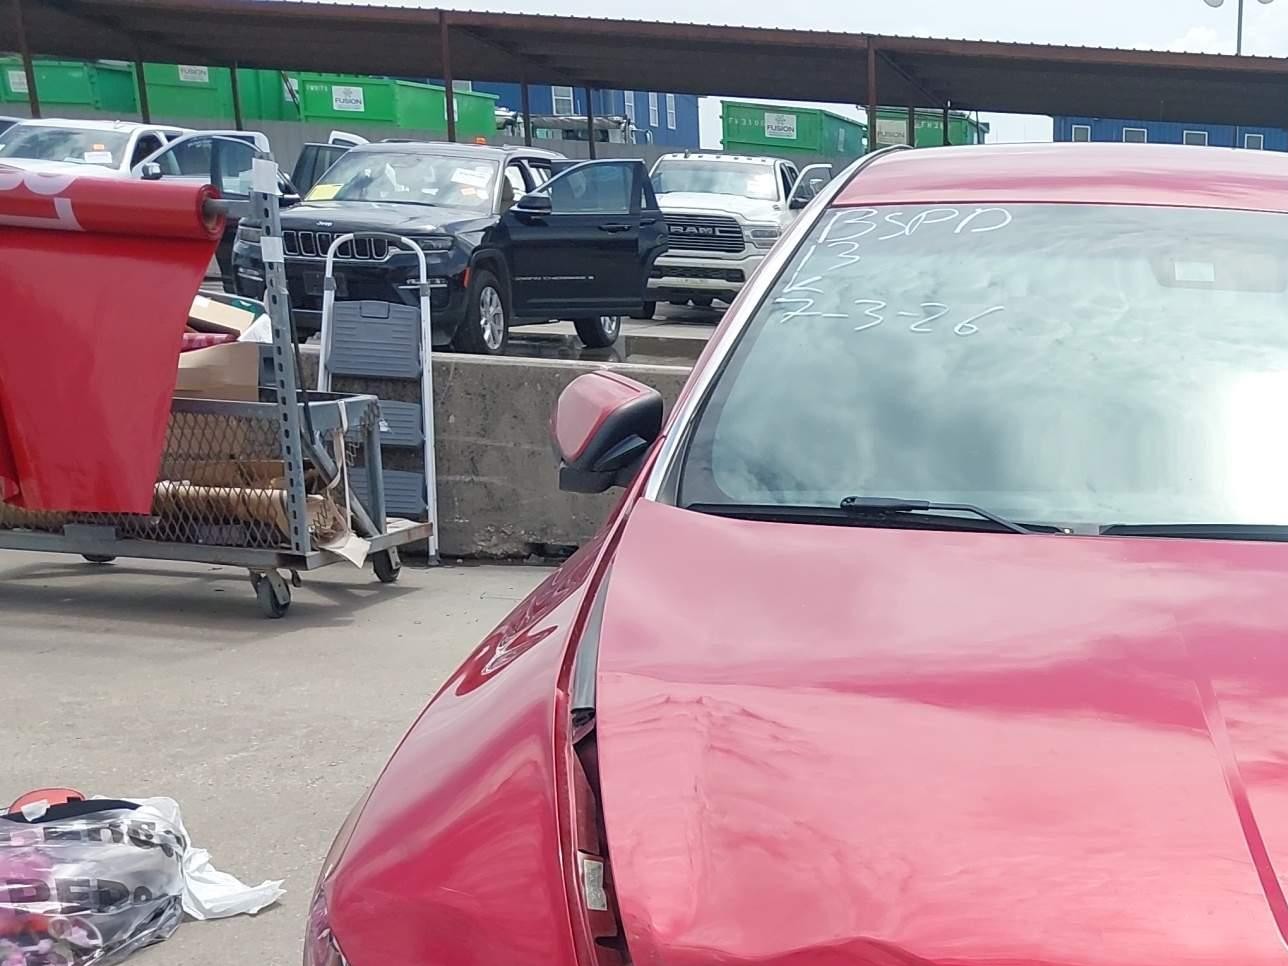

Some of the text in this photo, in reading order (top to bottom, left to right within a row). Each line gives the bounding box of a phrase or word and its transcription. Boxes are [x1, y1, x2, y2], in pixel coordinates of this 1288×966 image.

[335, 97, 362, 105] FUSION
[767, 124, 795, 133] FUSION
[877, 130, 905, 139] FUSION
[670, 226, 713, 234] RAM
[817, 208, 1013, 243] BSPD
